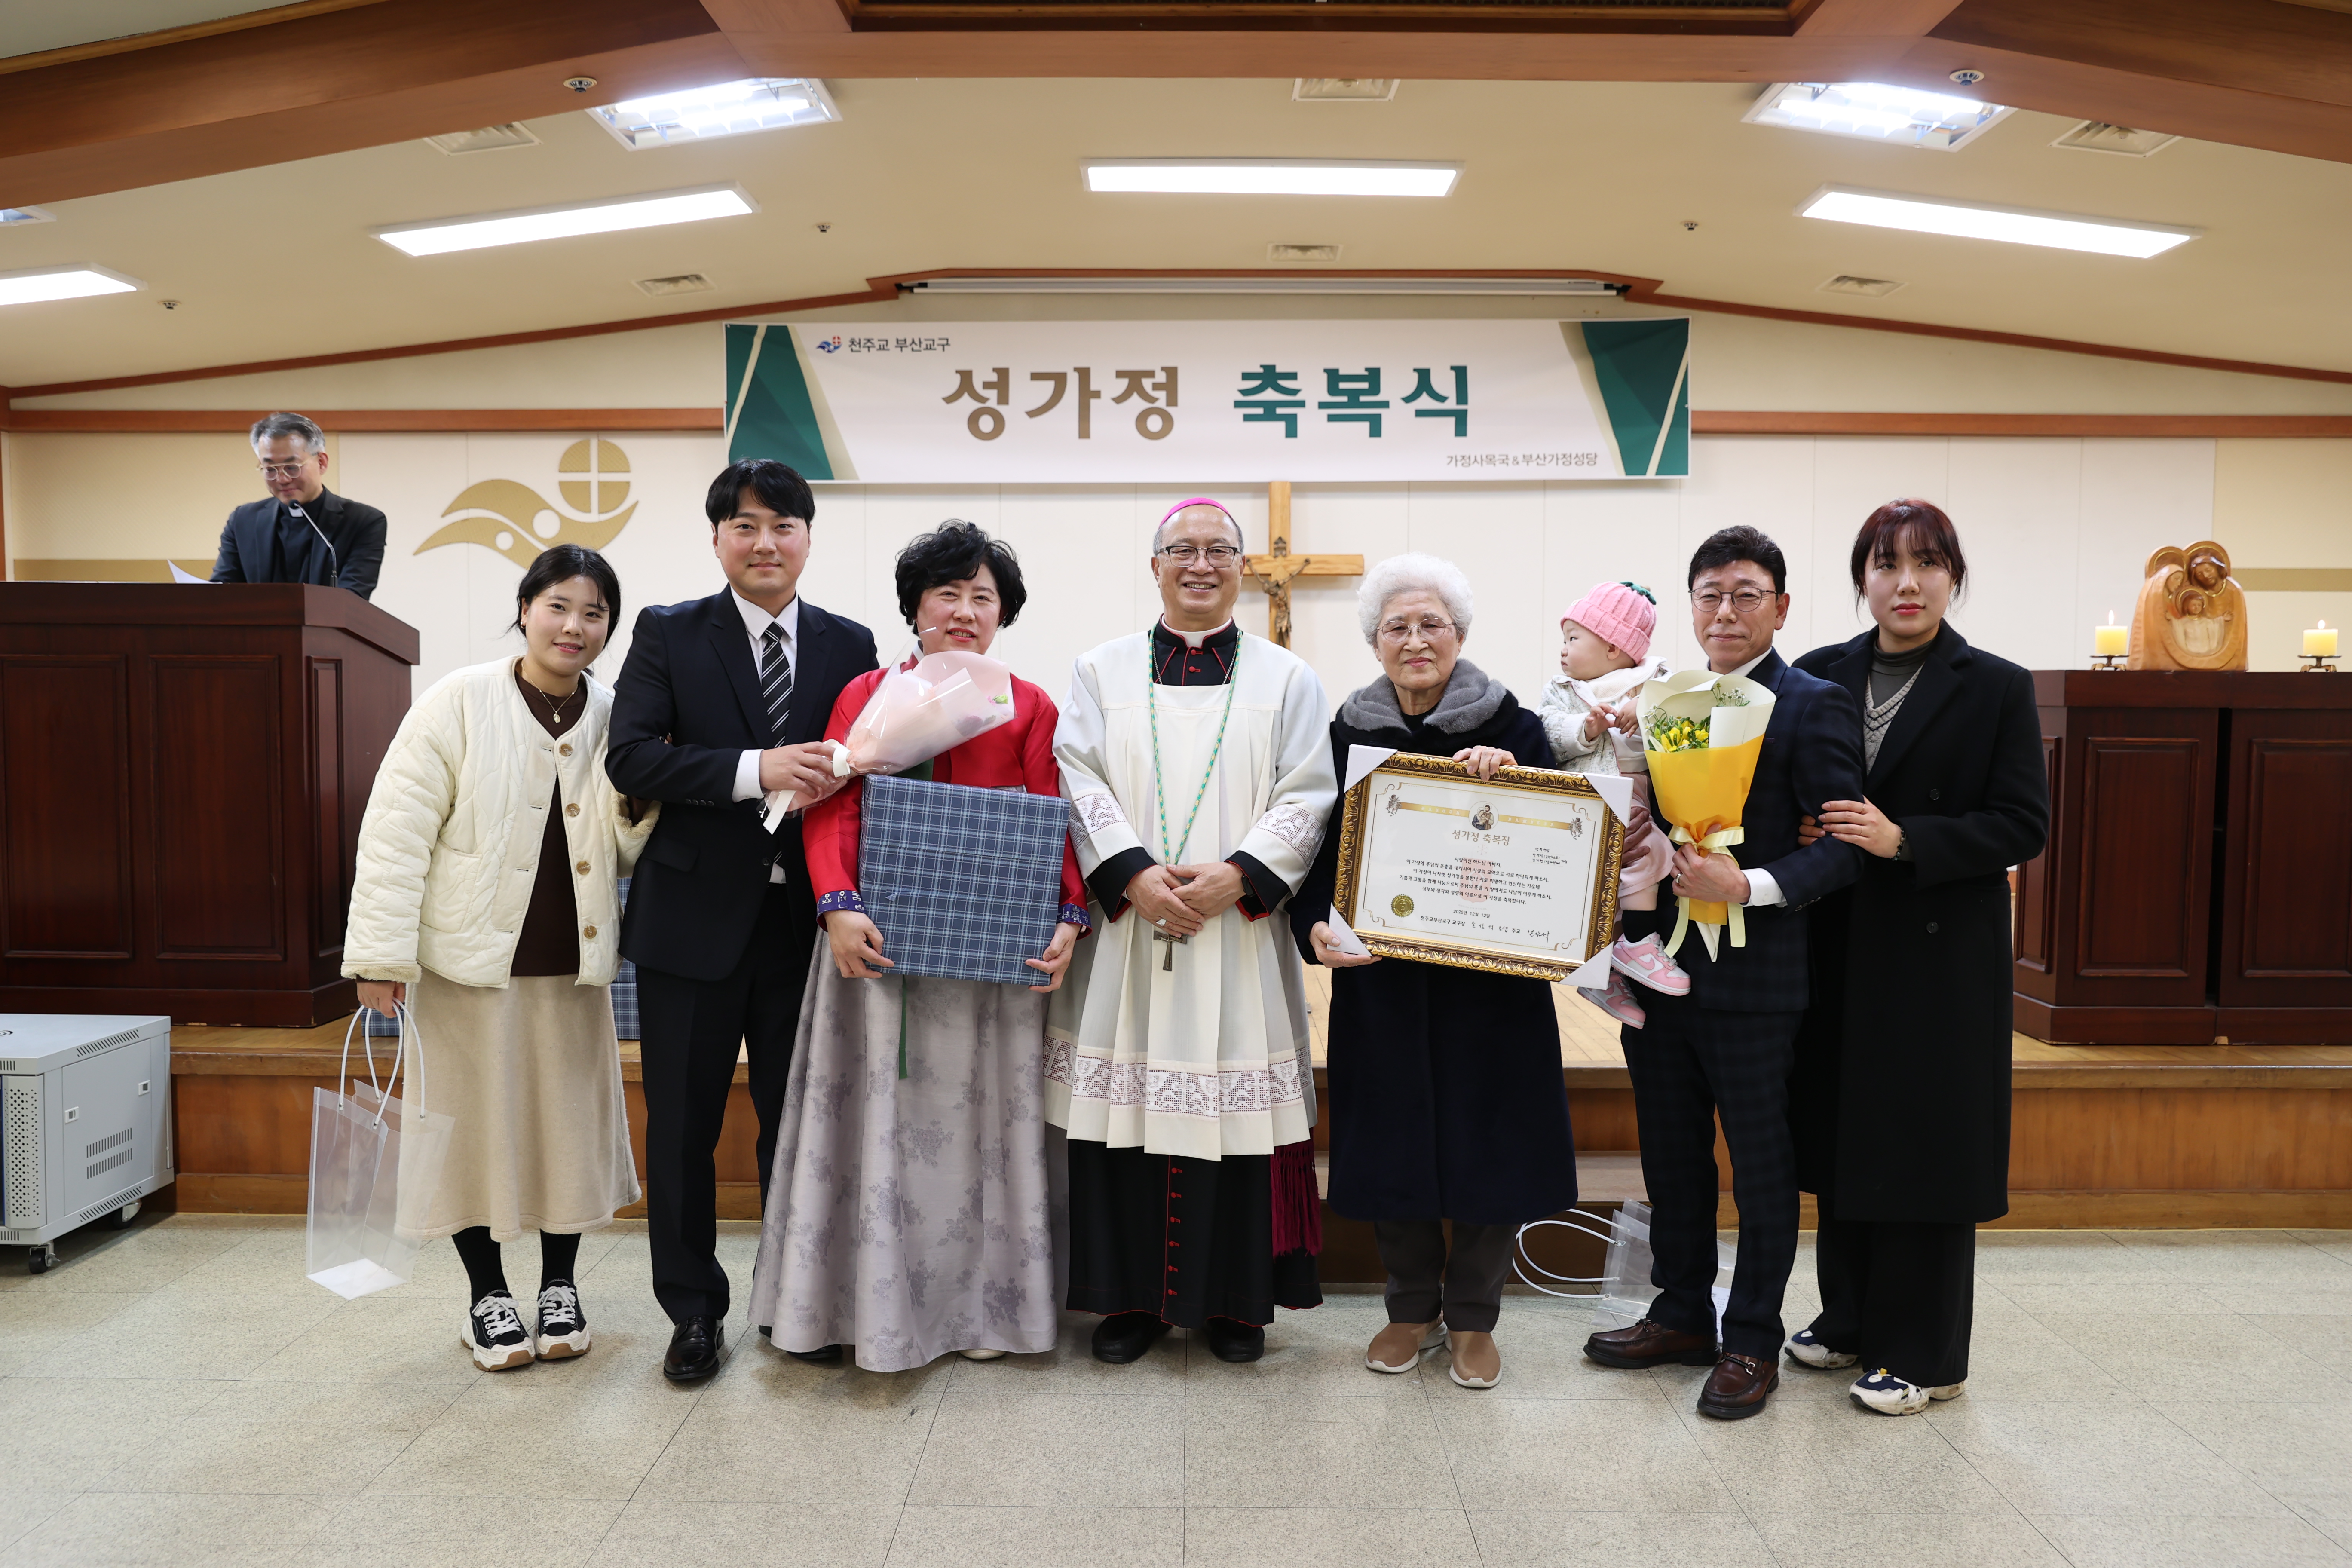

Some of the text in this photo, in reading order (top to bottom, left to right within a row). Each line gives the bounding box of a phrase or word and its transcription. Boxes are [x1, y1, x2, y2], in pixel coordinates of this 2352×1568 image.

[848, 337, 951, 352] 천주교 부산교구
[941, 364, 1469, 441] 성가정 축복식
[1452, 830, 1511, 846] 성가정 축복장
[1421, 916, 1451, 924] 천주교부산교구
